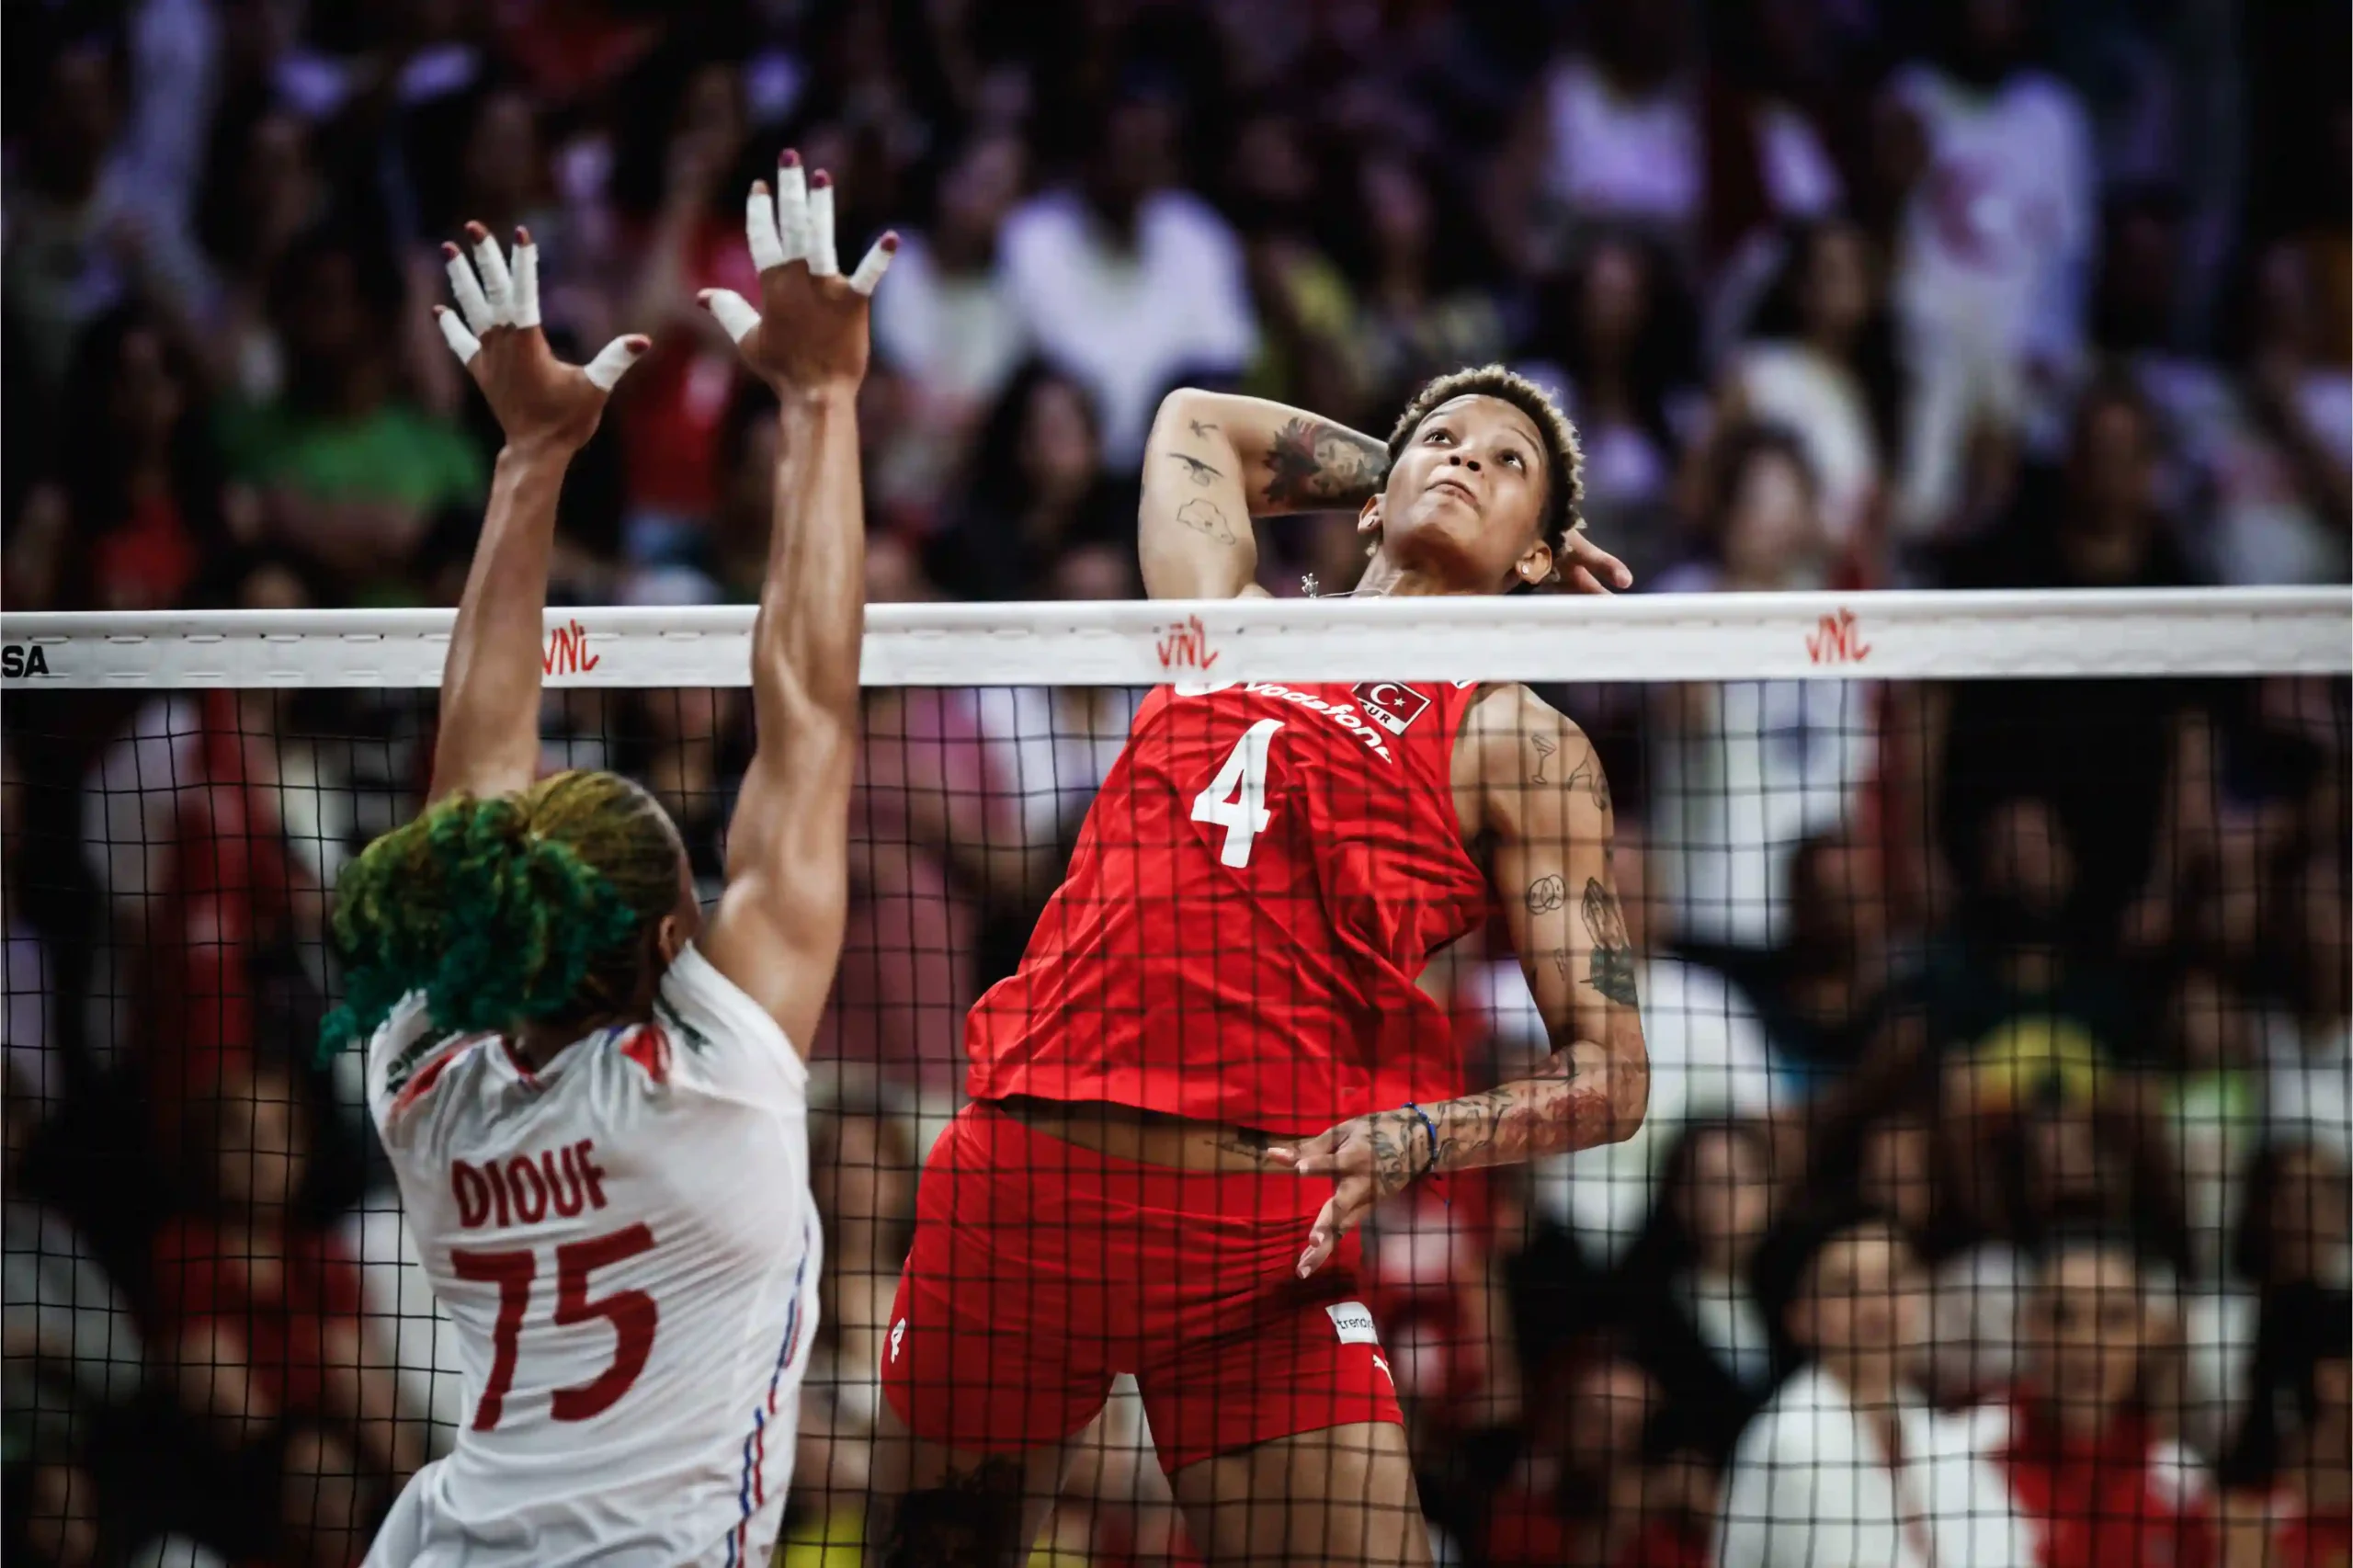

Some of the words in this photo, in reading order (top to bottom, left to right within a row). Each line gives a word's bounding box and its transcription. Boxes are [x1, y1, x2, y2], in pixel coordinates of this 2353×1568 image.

[1, 645, 49, 678] SA
[1361, 702, 1392, 724] UR
[1190, 718, 1286, 869] 4
[451, 1139, 608, 1228] DIOUF
[449, 1221, 659, 1432] 75
